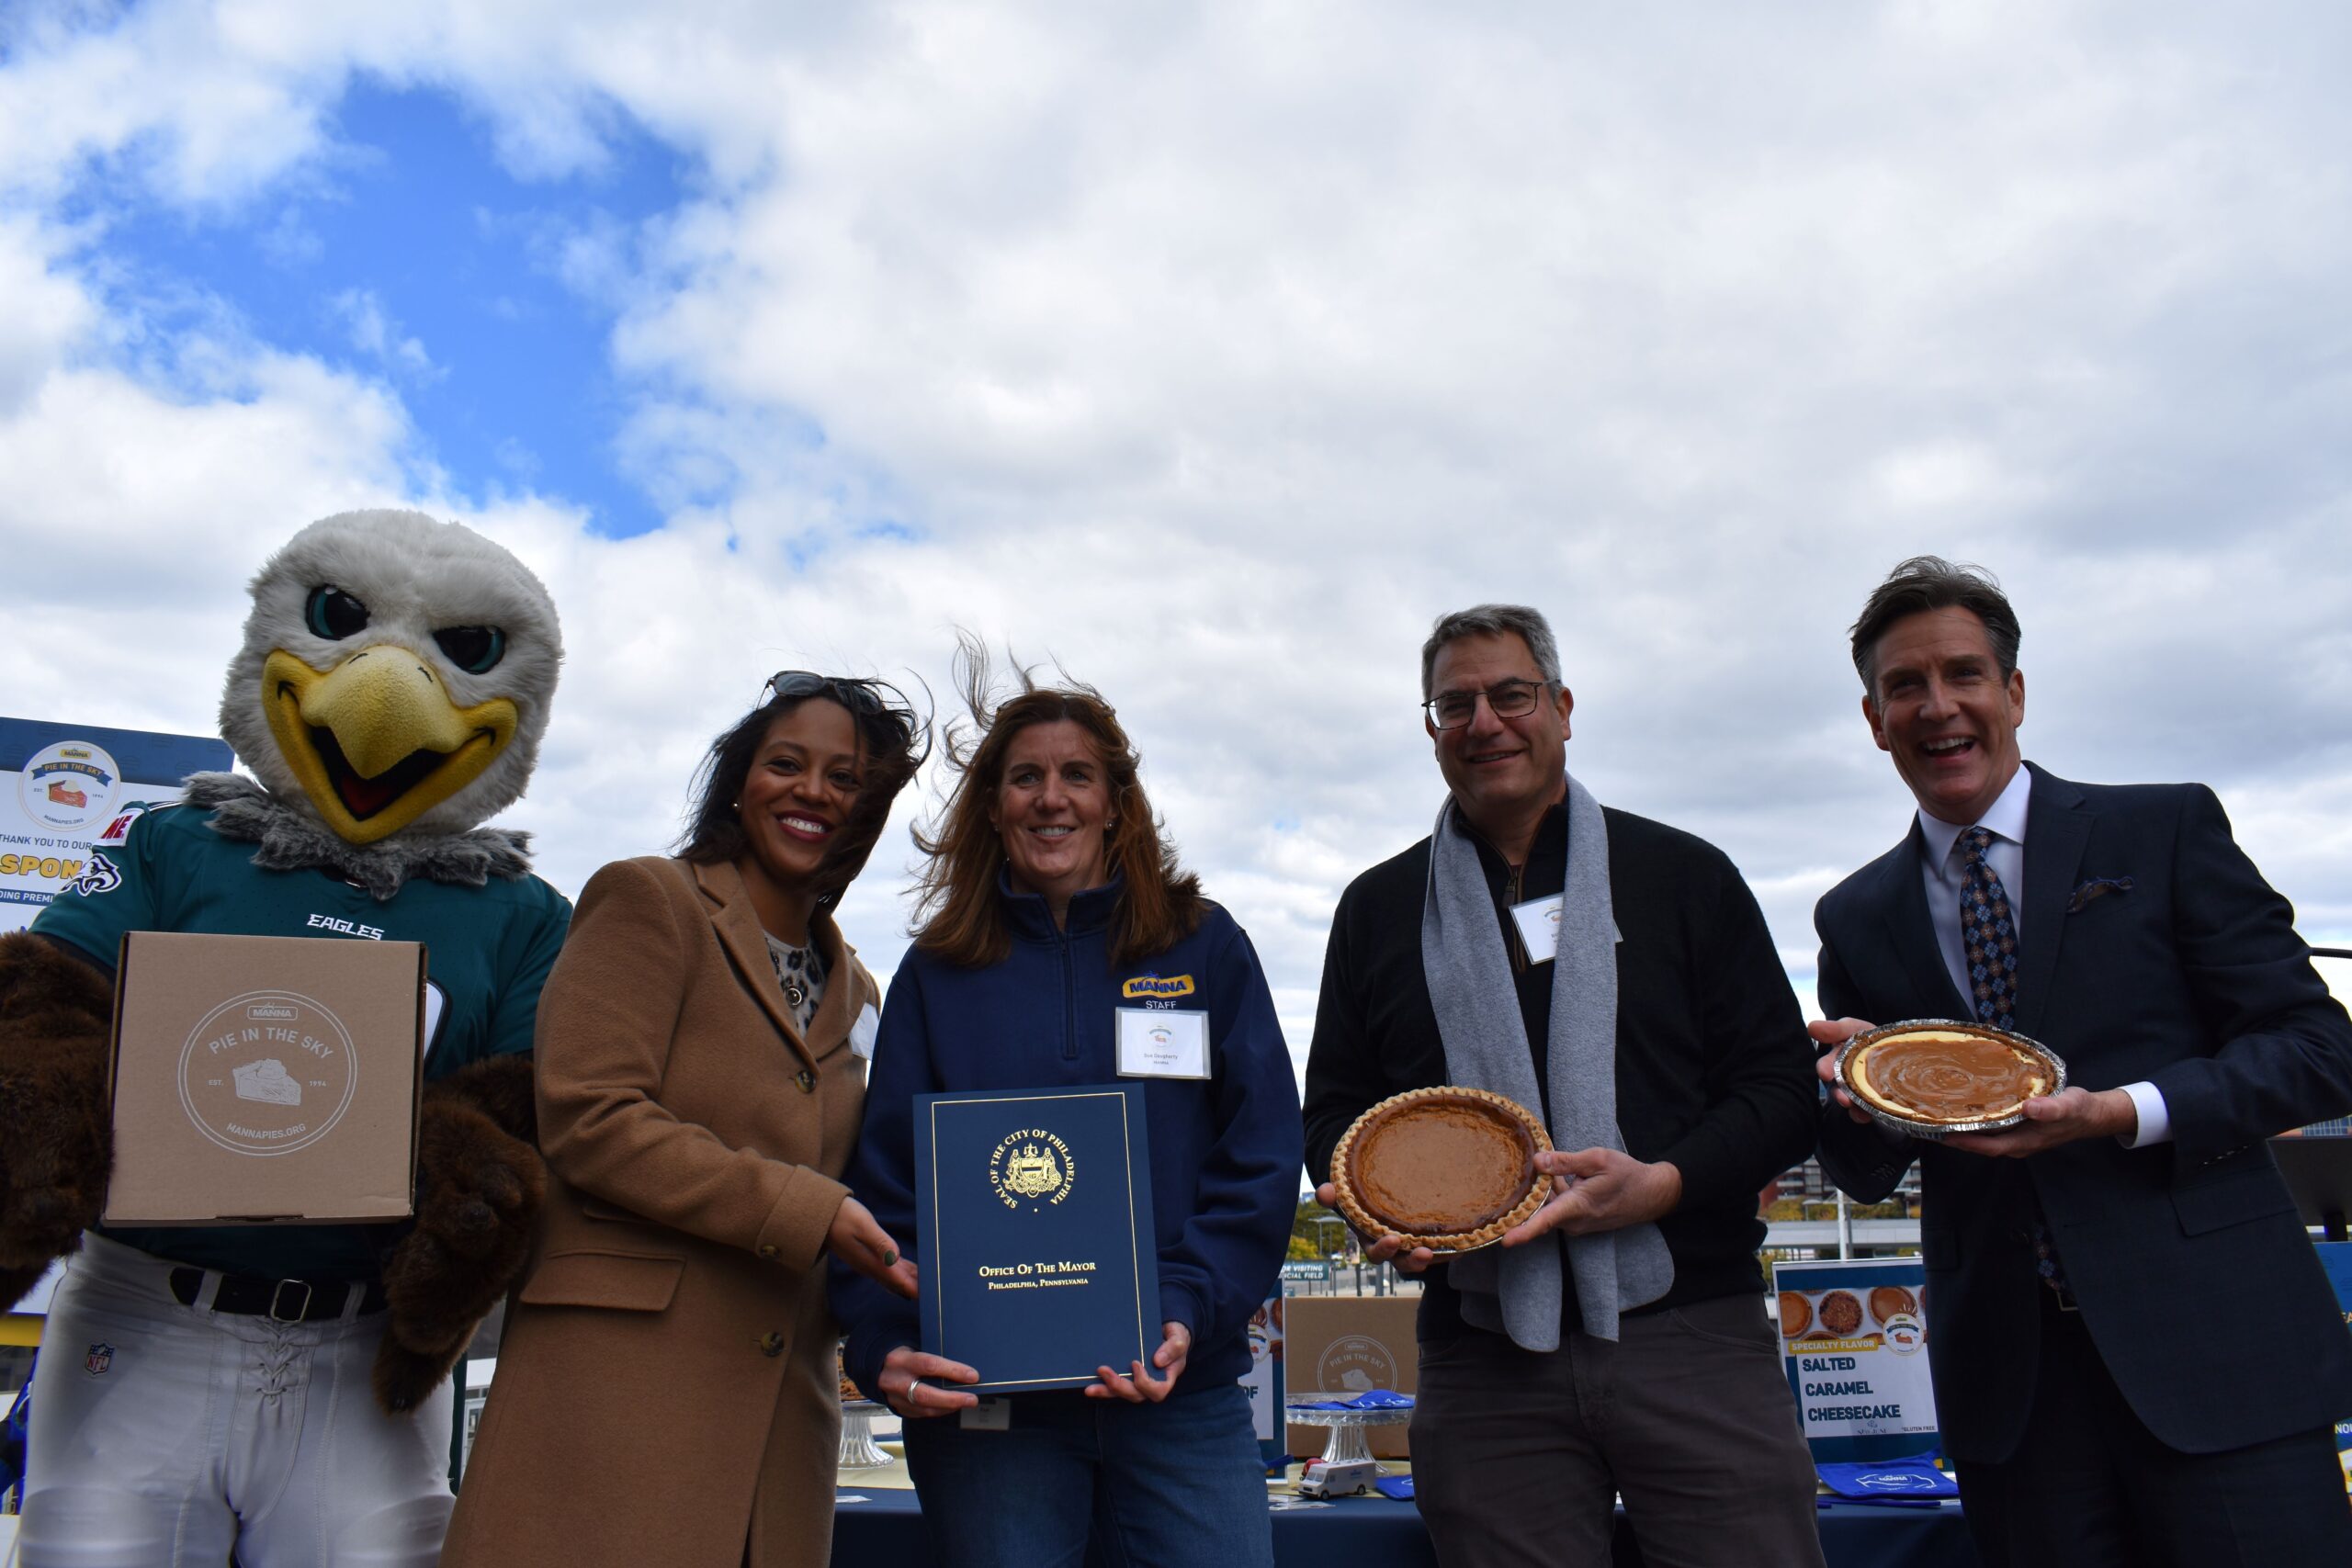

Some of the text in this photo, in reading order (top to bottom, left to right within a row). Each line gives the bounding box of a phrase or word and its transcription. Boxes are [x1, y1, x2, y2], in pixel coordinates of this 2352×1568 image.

[72, 763, 85, 772] THE
[87, 766, 103, 775] SKY
[44, 814, 84, 825] MANNAPIES.ORG
[0, 834, 92, 851] THANK YOU TO OUR
[307, 914, 385, 941] EAGLES
[1129, 980, 1187, 993] MANNA
[1146, 1000, 1177, 1010] STAFF
[253, 1009, 292, 1018] MANNA
[209, 1027, 334, 1059] PIE IN THE SKY
[226, 1122, 306, 1139] MANNAPIES.ORG
[990, 1129, 1075, 1209] SEAL OF THE CITY OF PHILADELPHIA
[979, 1261, 1096, 1277] OFFICE OF THE MAYOR
[1294, 1264, 1323, 1272] VISITING
[988, 1278, 1089, 1290] PHILADELPHIA, PENNSYLVANIA
[1792, 1340, 1875, 1350] SPECIALTY FLAVOR
[86, 1355, 107, 1371] NFL
[1354, 1353, 1368, 1361] THE
[1803, 1357, 1856, 1372] SALTED
[1805, 1381, 1873, 1396] CARAMEL
[1807, 1404, 1901, 1421] CHEESECAKE
